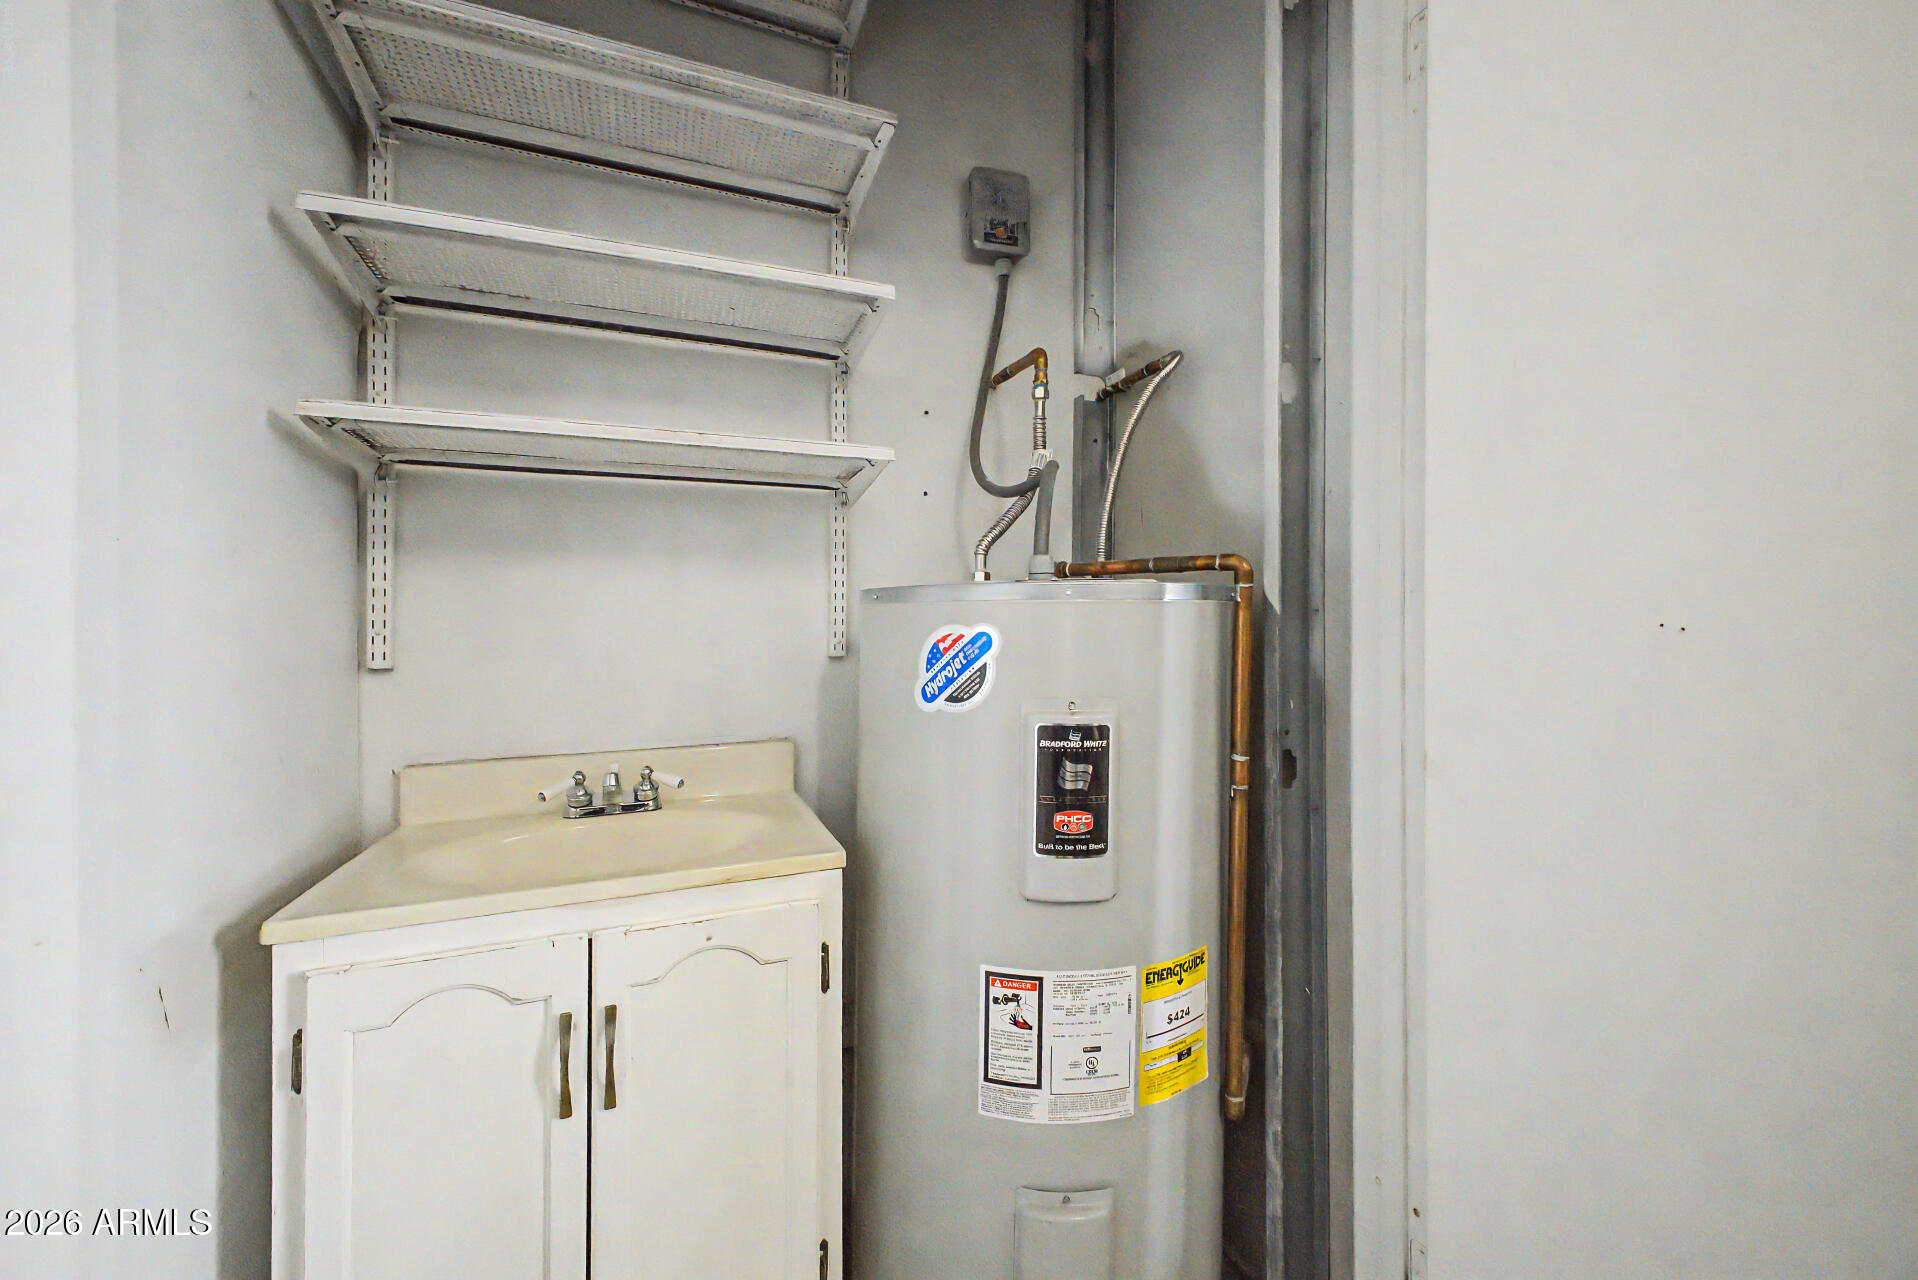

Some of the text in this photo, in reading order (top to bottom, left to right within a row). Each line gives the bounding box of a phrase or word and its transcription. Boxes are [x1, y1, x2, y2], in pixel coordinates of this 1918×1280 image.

[924, 650, 967, 698] Hydrojet
[1040, 740, 1107, 748] BRADFORD WHITE
[1056, 815, 1092, 823] PHCC
[1038, 842, 1054, 850] Built
[1002, 981, 1032, 989] DANGER
